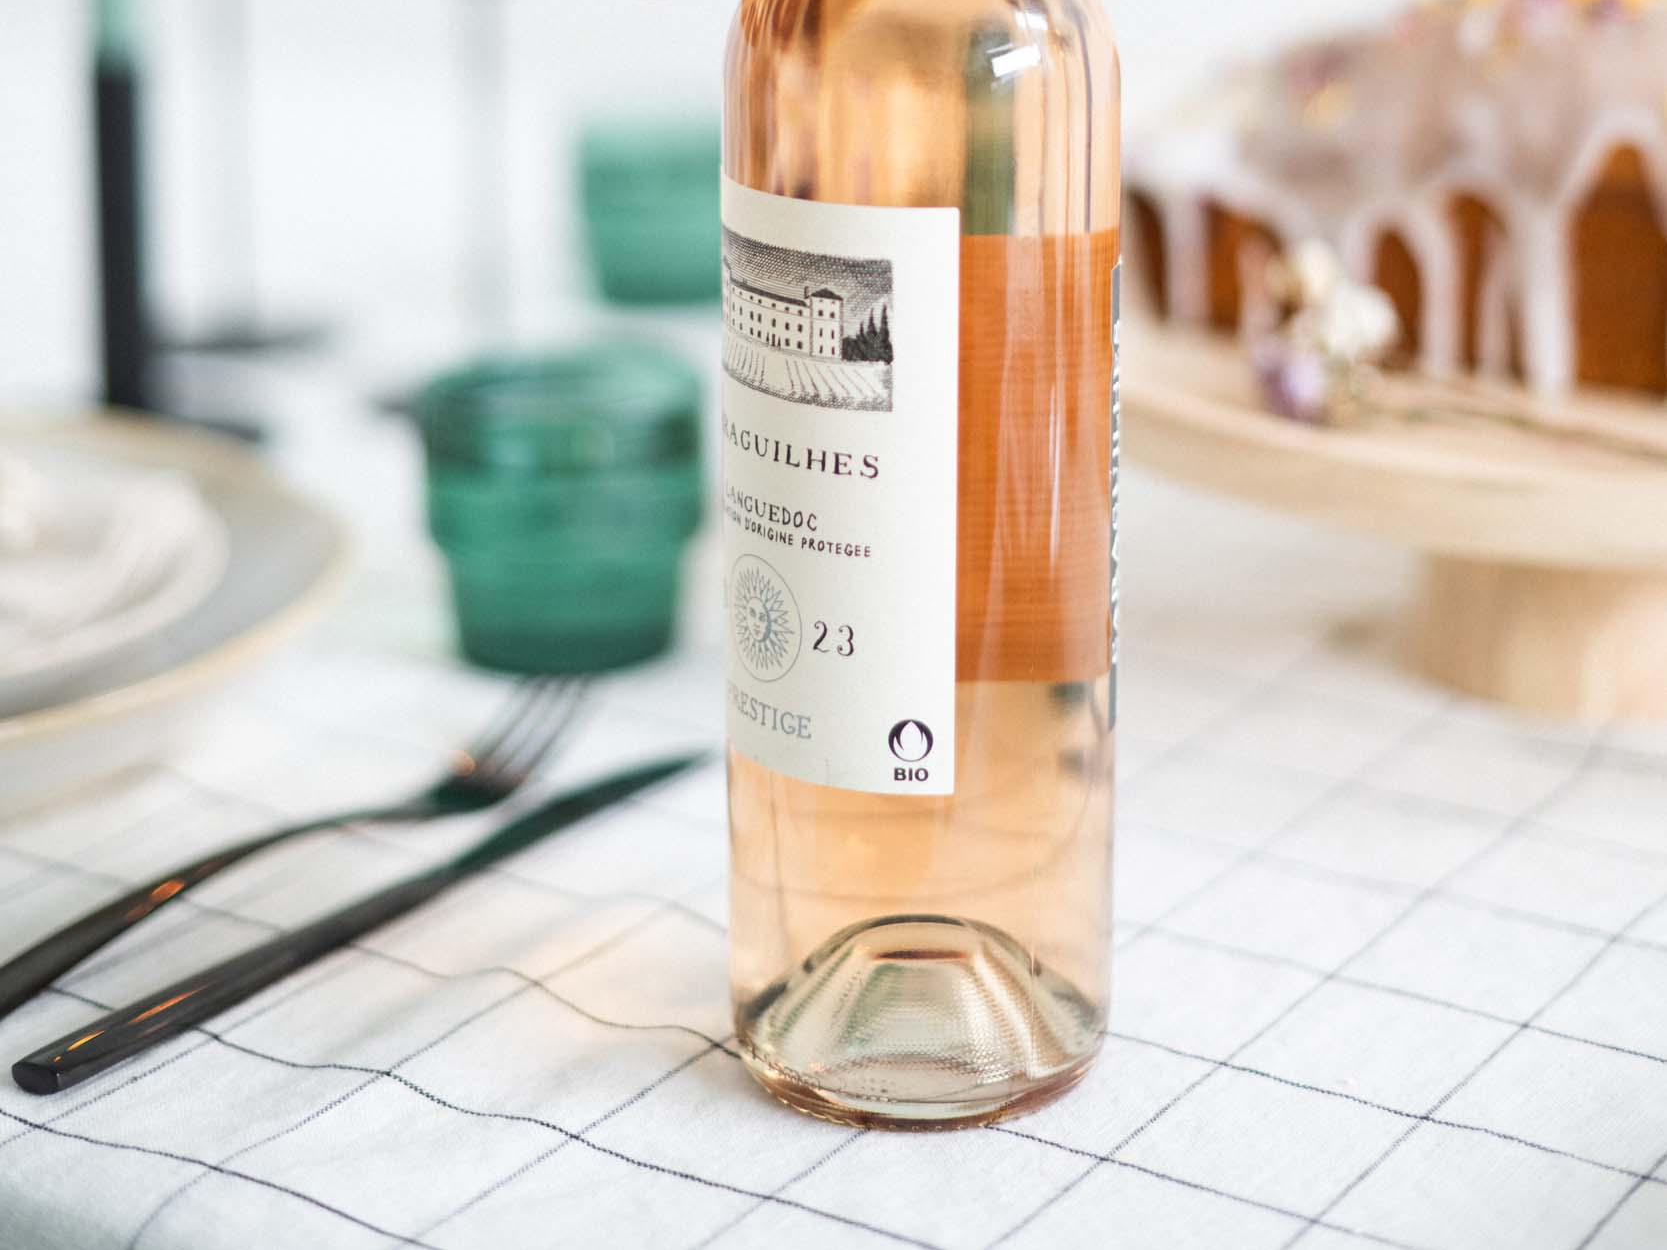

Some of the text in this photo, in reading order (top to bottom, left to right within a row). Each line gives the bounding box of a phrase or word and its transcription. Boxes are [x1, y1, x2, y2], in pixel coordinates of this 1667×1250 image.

[801, 536, 871, 558] PROTEGEE
[812, 620, 854, 657] 23
[893, 766, 929, 782] BIO
